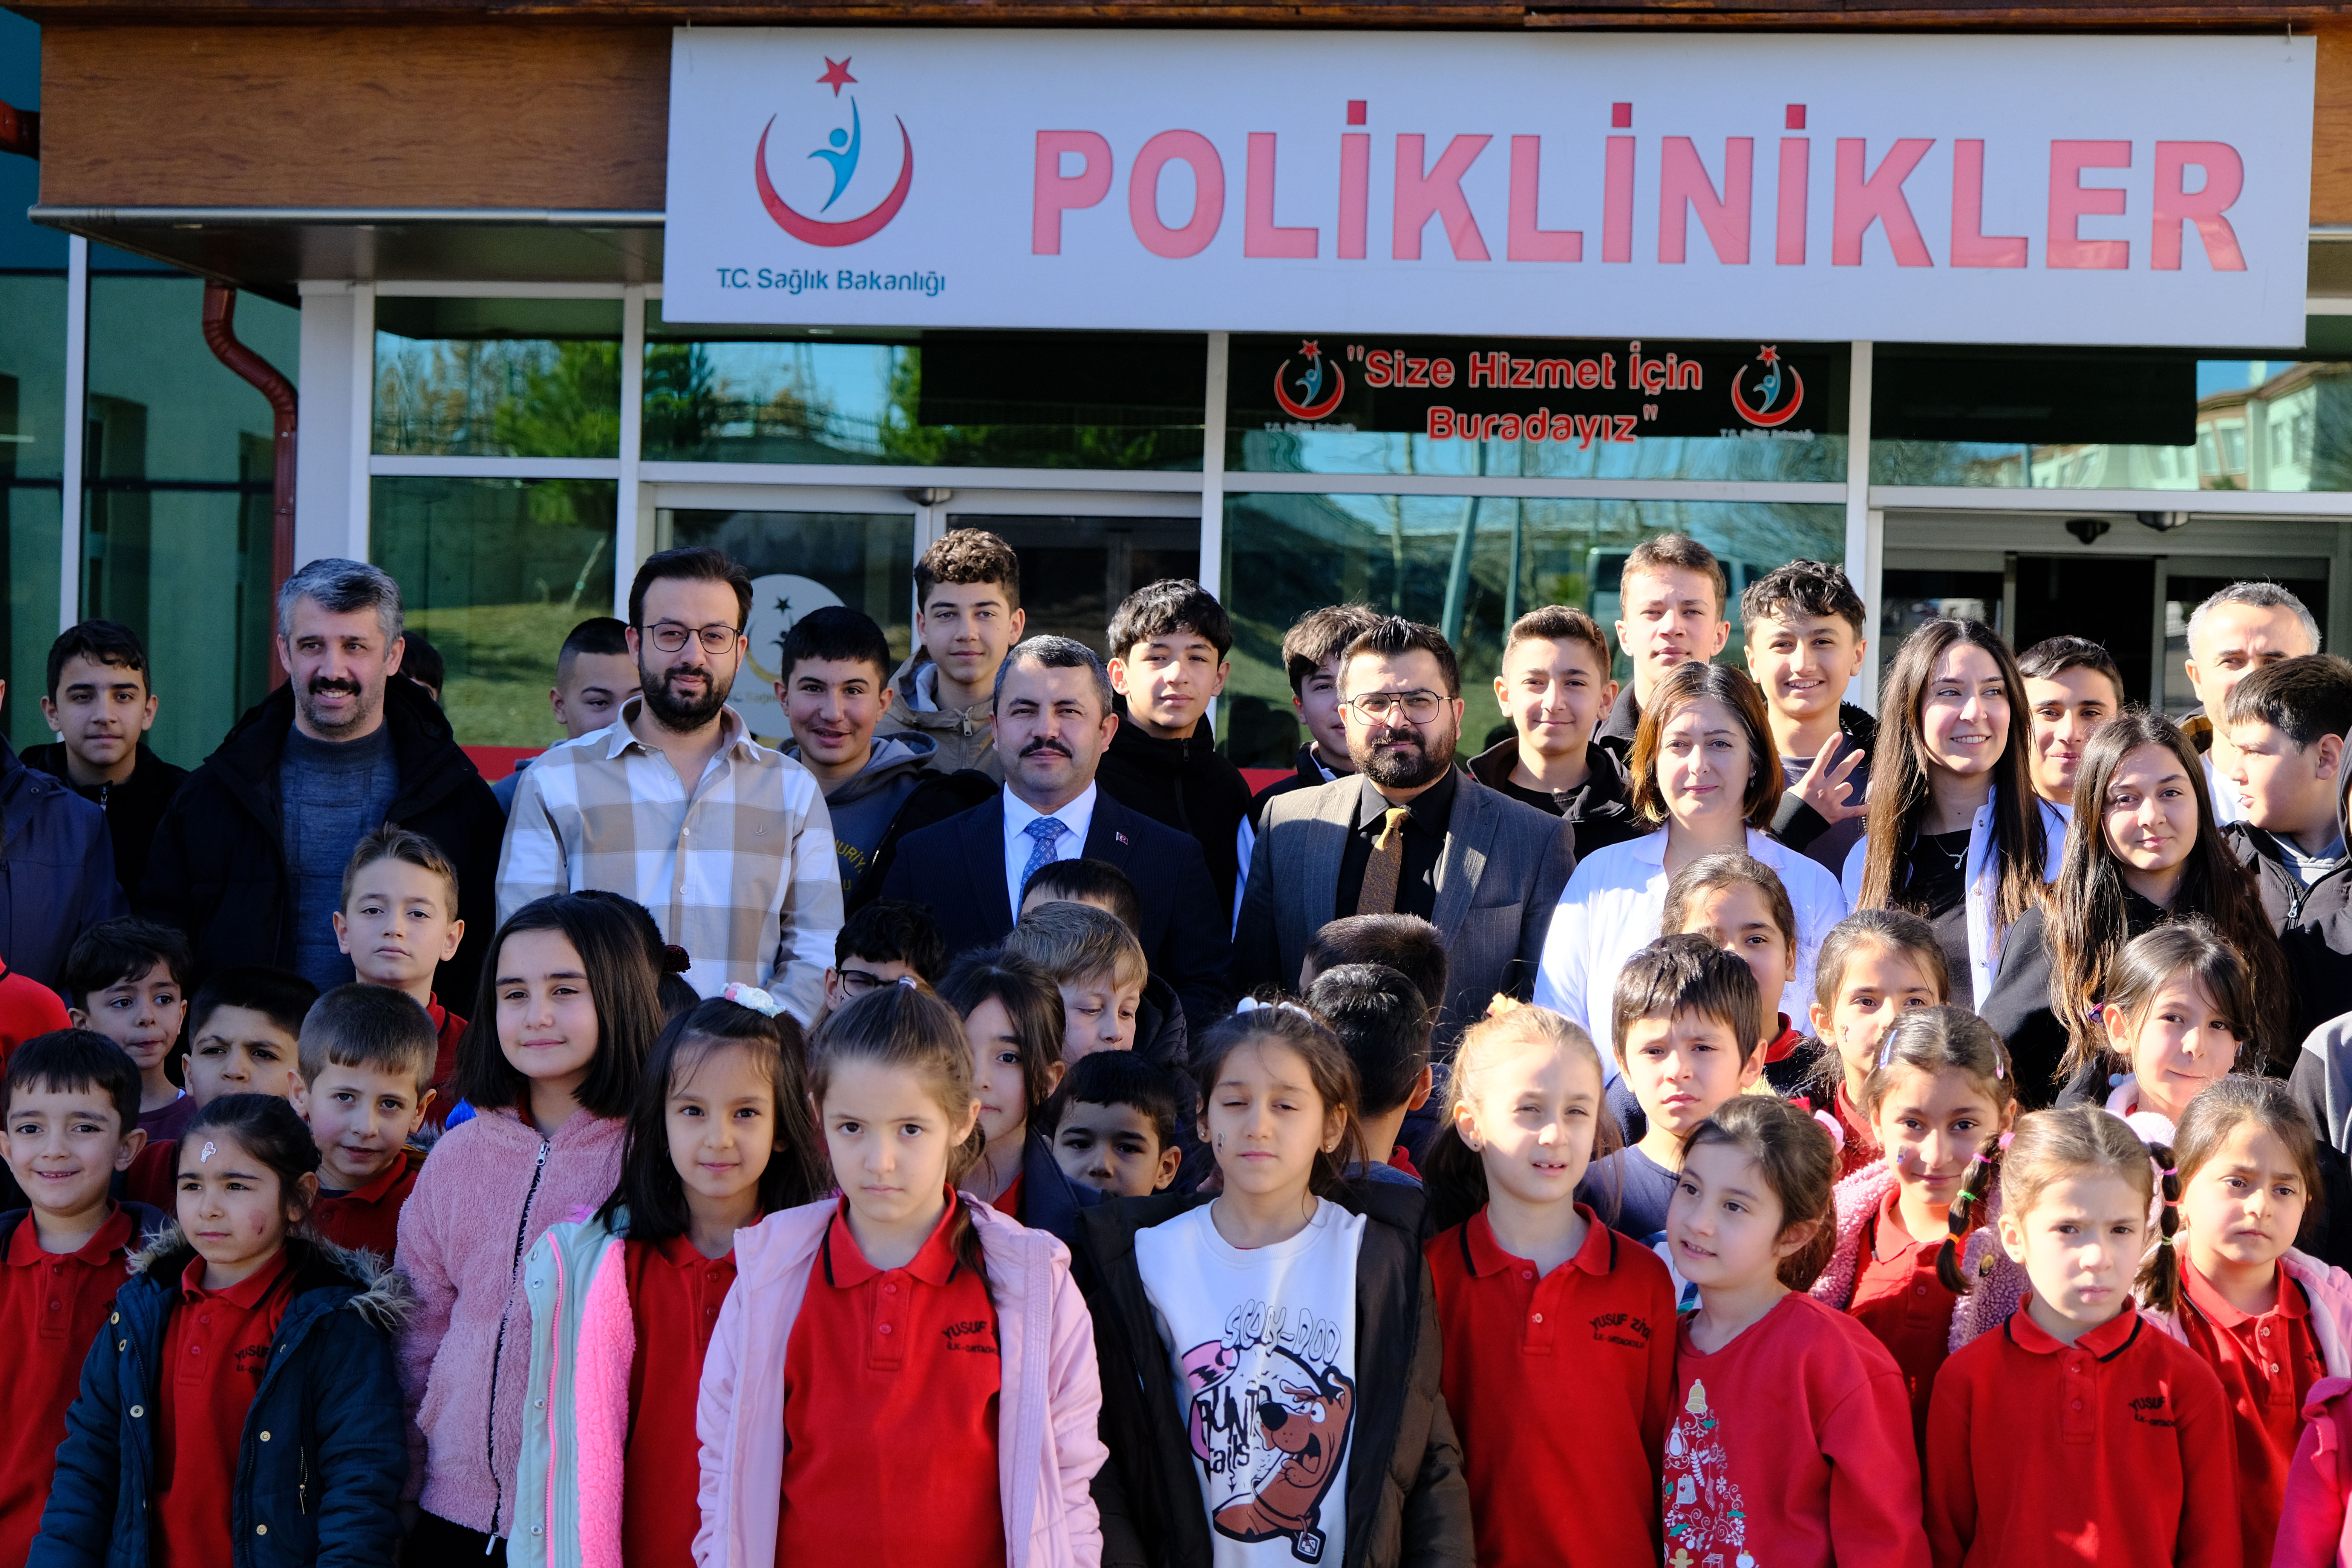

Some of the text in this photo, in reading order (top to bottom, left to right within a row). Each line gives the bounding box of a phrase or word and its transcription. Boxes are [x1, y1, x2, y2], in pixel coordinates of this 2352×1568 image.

[1031, 100, 2248, 271] POLİKLİNİKLER
[716, 268, 946, 297] T.C. Sağlık Bakanlığı
[1468, 351, 1616, 389] Hizmet
[1629, 341, 1703, 395] İçin
[942, 1321, 987, 1340] YUSUF
[1589, 1313, 1628, 1331] YUSUF
